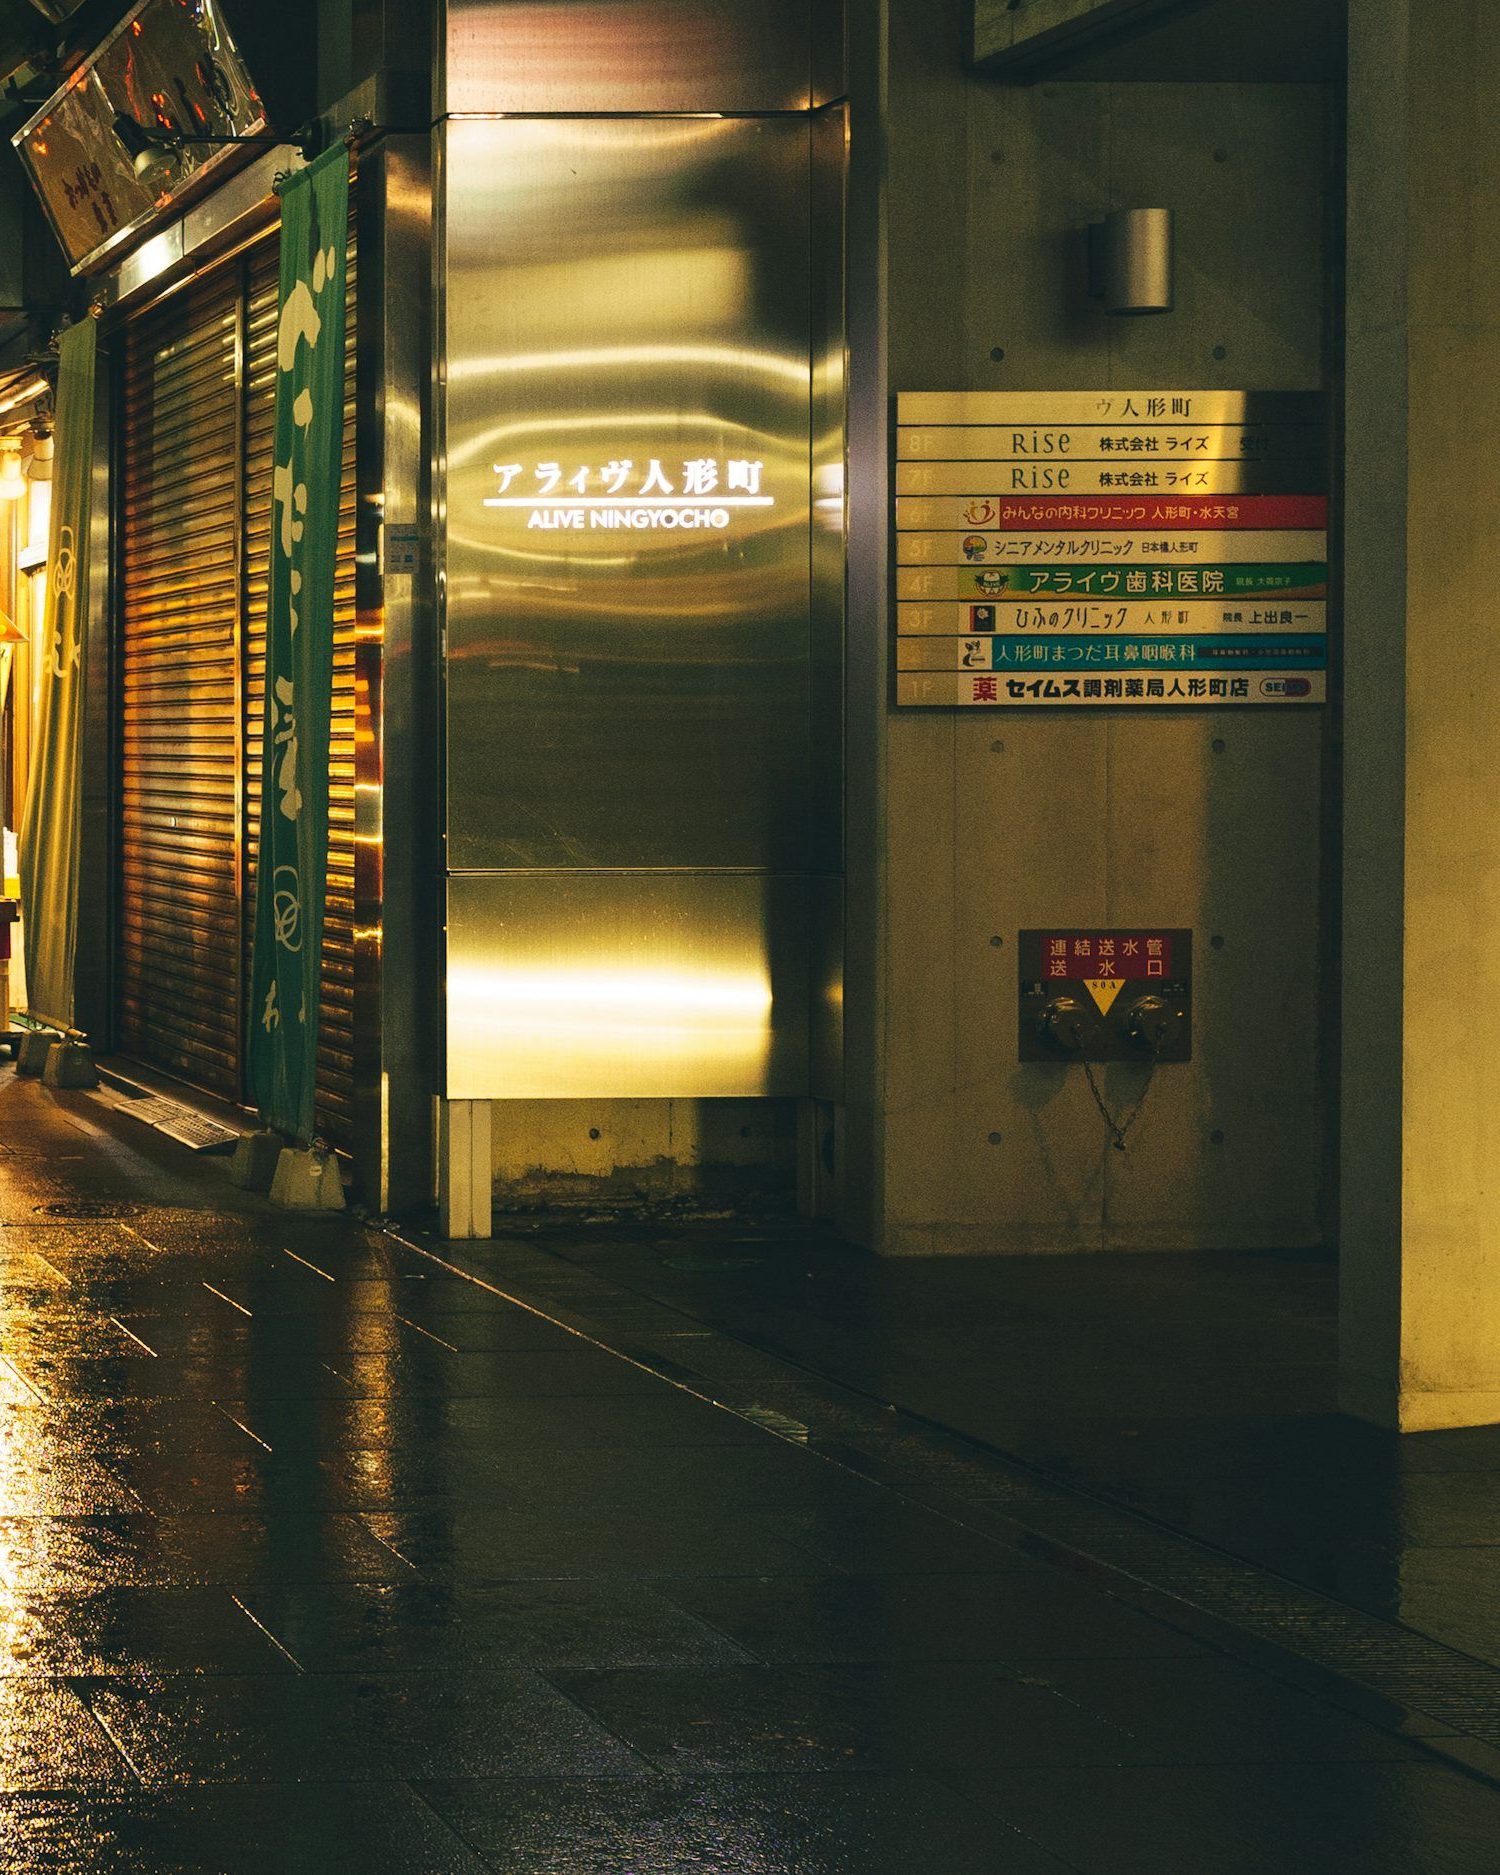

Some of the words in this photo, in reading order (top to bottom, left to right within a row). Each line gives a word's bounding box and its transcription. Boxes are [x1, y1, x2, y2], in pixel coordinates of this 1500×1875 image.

[1011, 431, 1070, 453] Rise
[1099, 437, 1159, 451] 株式会社
[1165, 436, 1210, 450] ライズ
[1011, 465, 1070, 489] Rise
[1099, 472, 1158, 487] 株式会社
[1165, 471, 1209, 486] ライズ
[527, 509, 586, 529] ALIVE
[591, 509, 730, 529] NINGYOCHO
[1152, 506, 1240, 520] 人形町・水天宮
[994, 540, 1134, 556] シニアメンタルクリニック
[1141, 542, 1199, 553] 日本橋人形町
[1029, 571, 1225, 594] アライヴ歯科医院
[1016, 607, 1128, 629] ひふのクリニック
[1144, 610, 1189, 625] 人形町
[1223, 612, 1243, 622] 院長
[995, 644, 1196, 662] 人形町まつだ耳鼻咽喉科
[973, 676, 998, 701] 薬
[1006, 678, 1249, 698] セイムス調剤薬局人形町店
[1050, 939, 1163, 957] 連結送水管
[1050, 959, 1163, 977] 送水口
